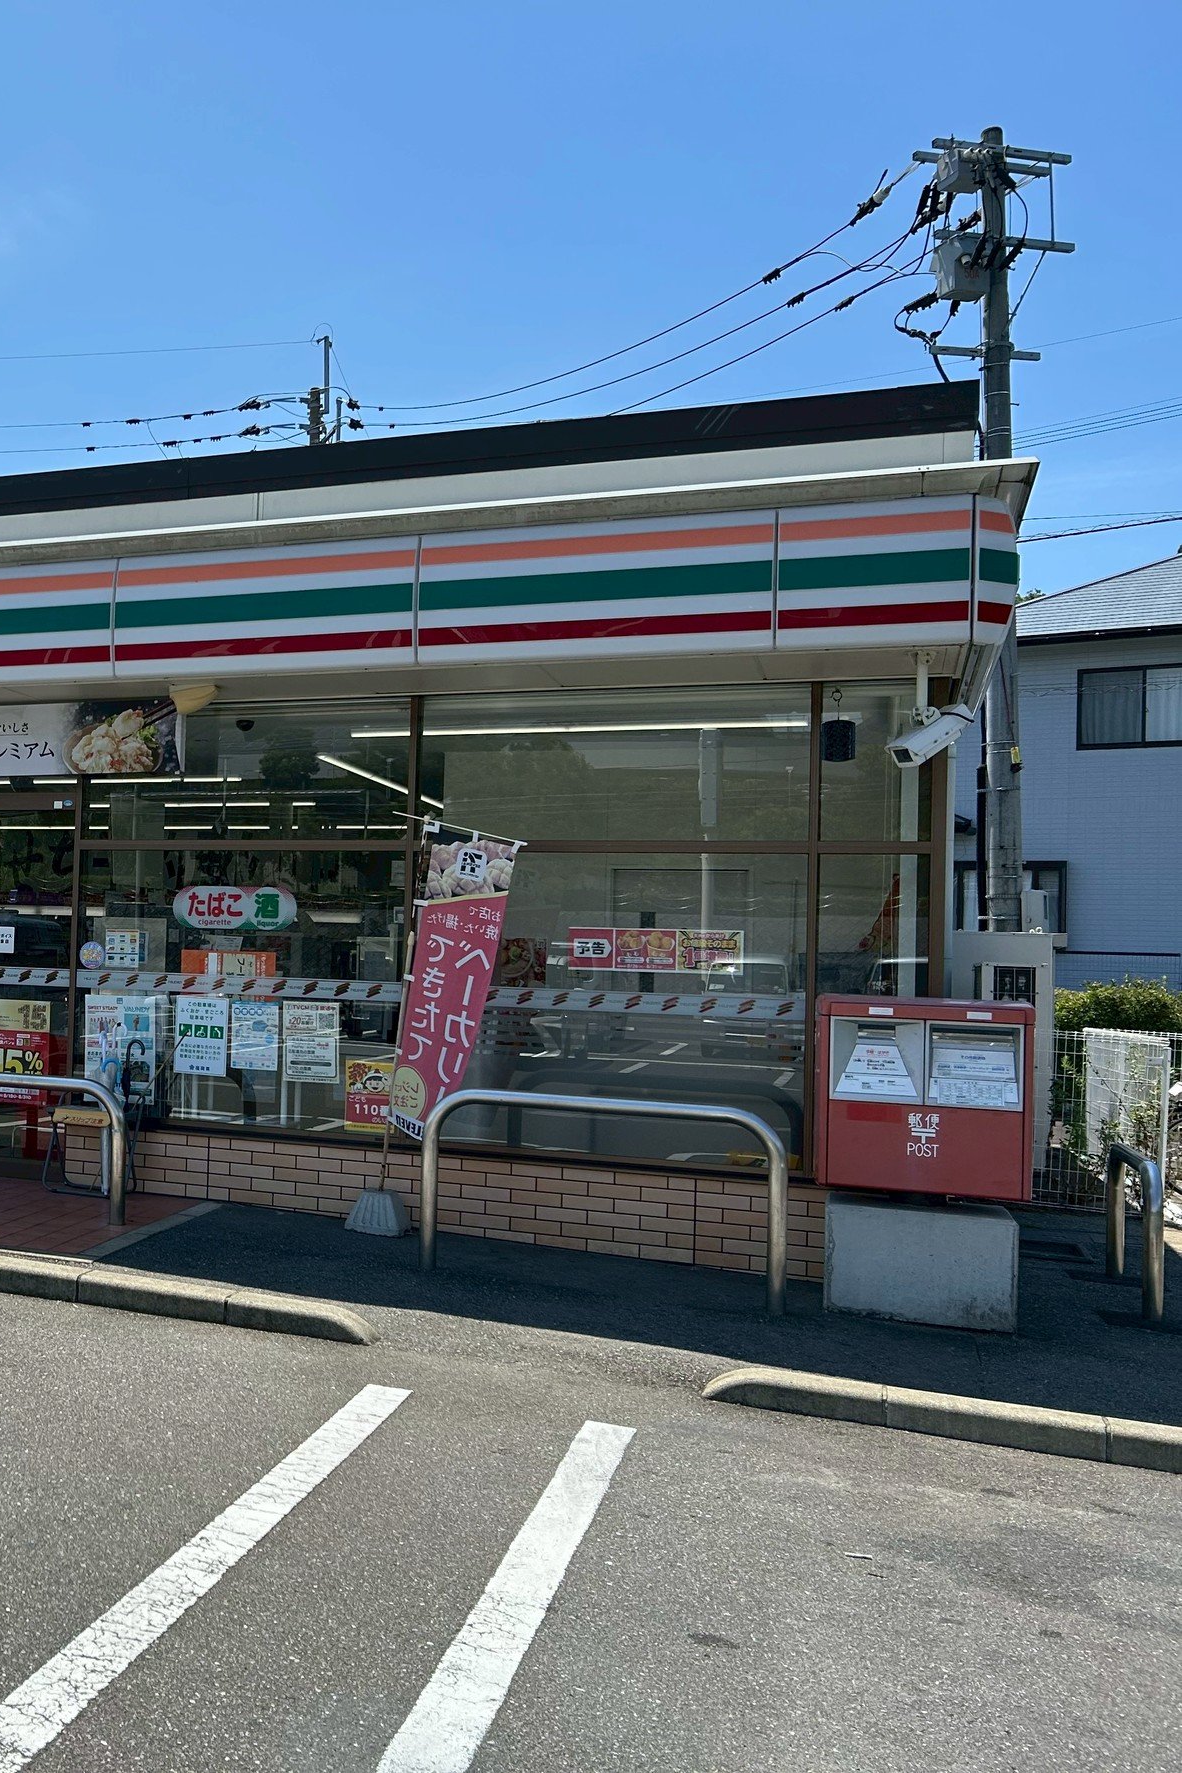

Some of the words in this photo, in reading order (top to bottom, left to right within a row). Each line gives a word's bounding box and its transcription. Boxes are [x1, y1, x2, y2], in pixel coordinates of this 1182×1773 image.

[188, 892, 243, 917] たばこ
[255, 893, 280, 918] 酒
[576, 941, 606, 955] 予告
[907, 1113, 940, 1130] 郵便
[907, 1143, 939, 1158] POST
